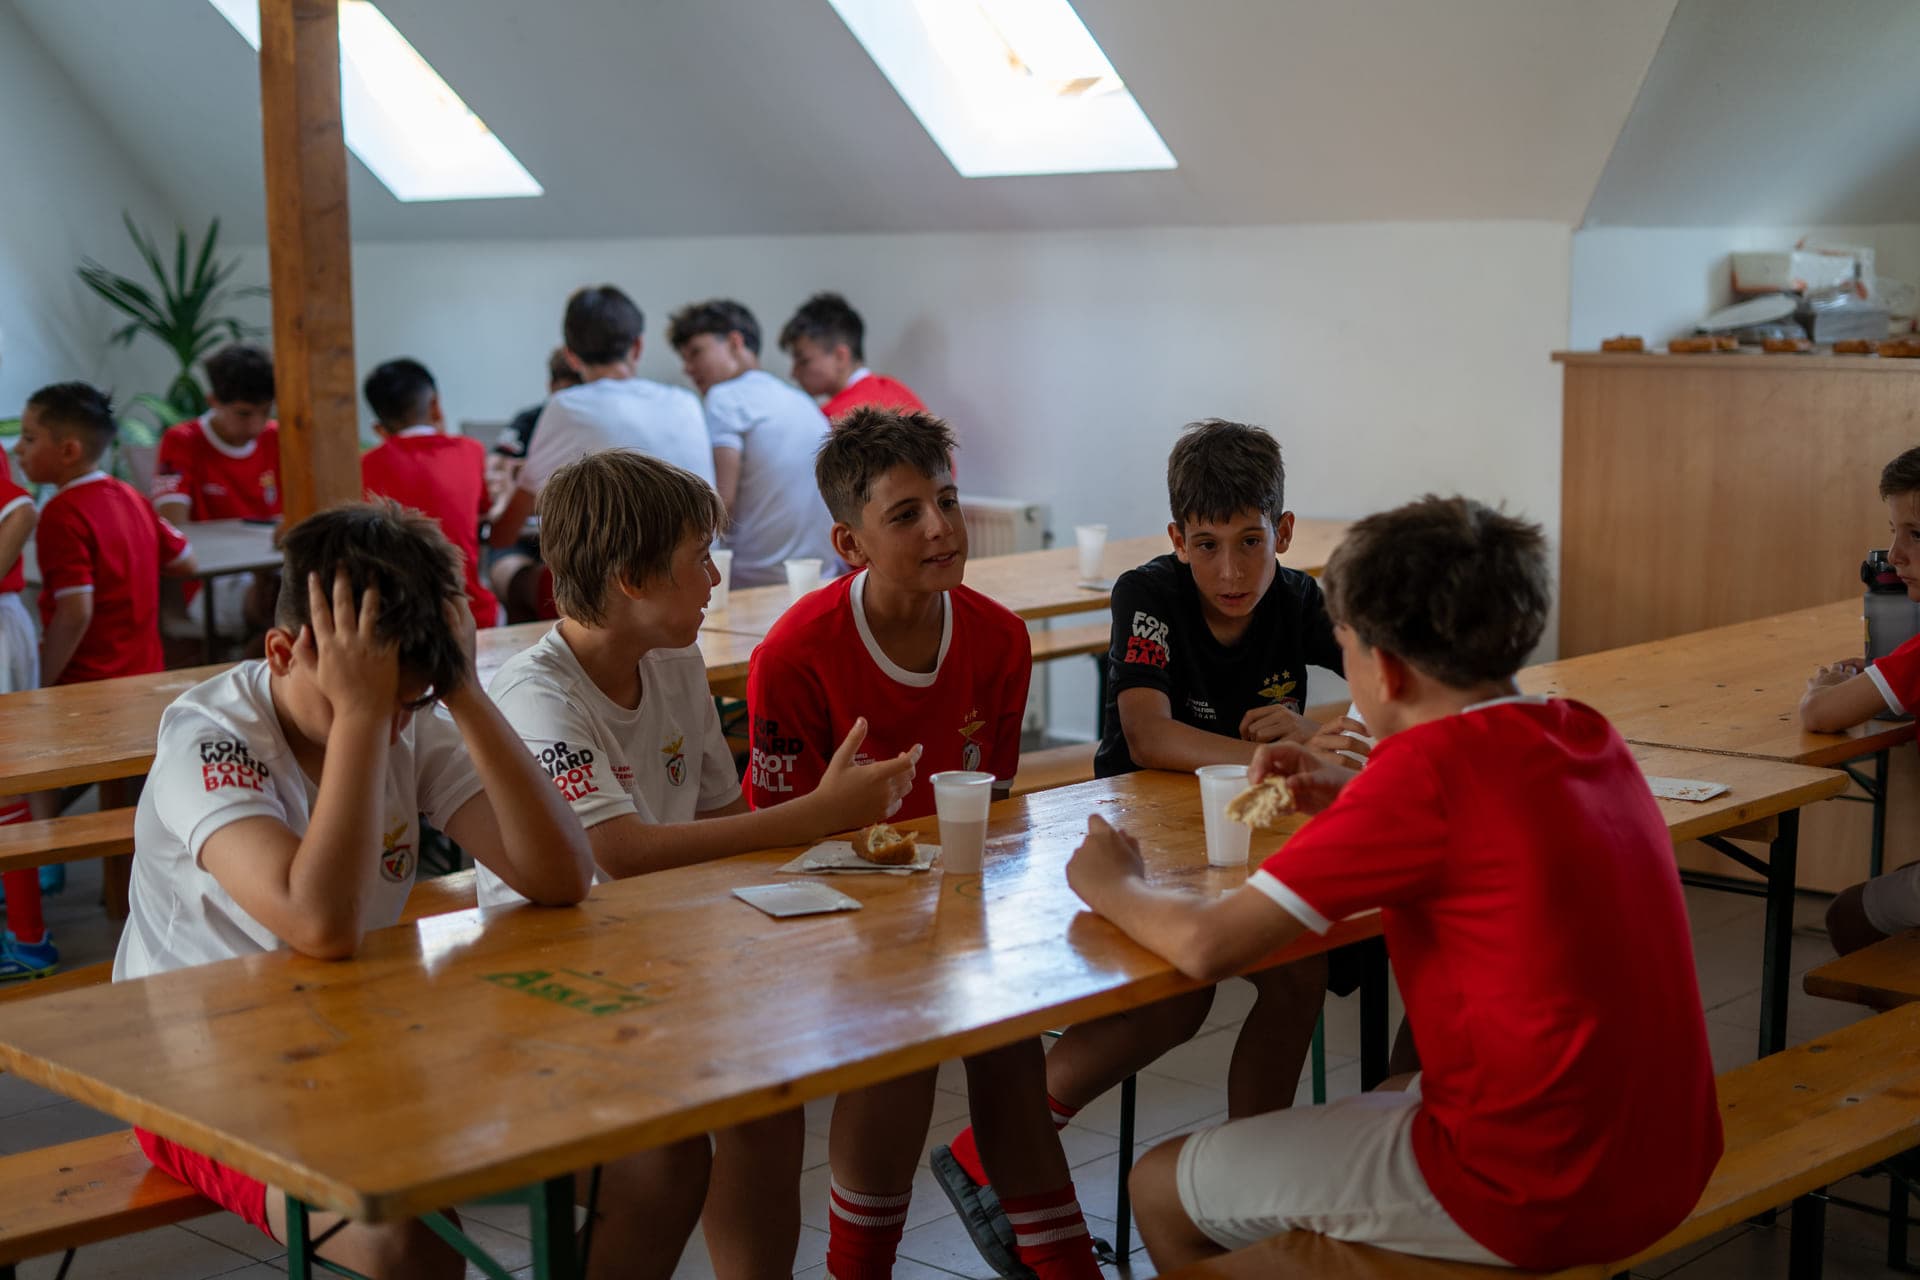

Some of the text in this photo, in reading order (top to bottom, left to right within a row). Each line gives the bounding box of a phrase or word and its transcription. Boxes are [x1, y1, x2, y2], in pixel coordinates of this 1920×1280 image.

[200, 740, 249, 757] FOR
[536, 741, 570, 764] OR
[752, 747, 797, 773] FOOT
[200, 752, 270, 778] WARD
[553, 764, 593, 790] OOT
[204, 773, 264, 793] BALL
[752, 765, 794, 793] BALL
